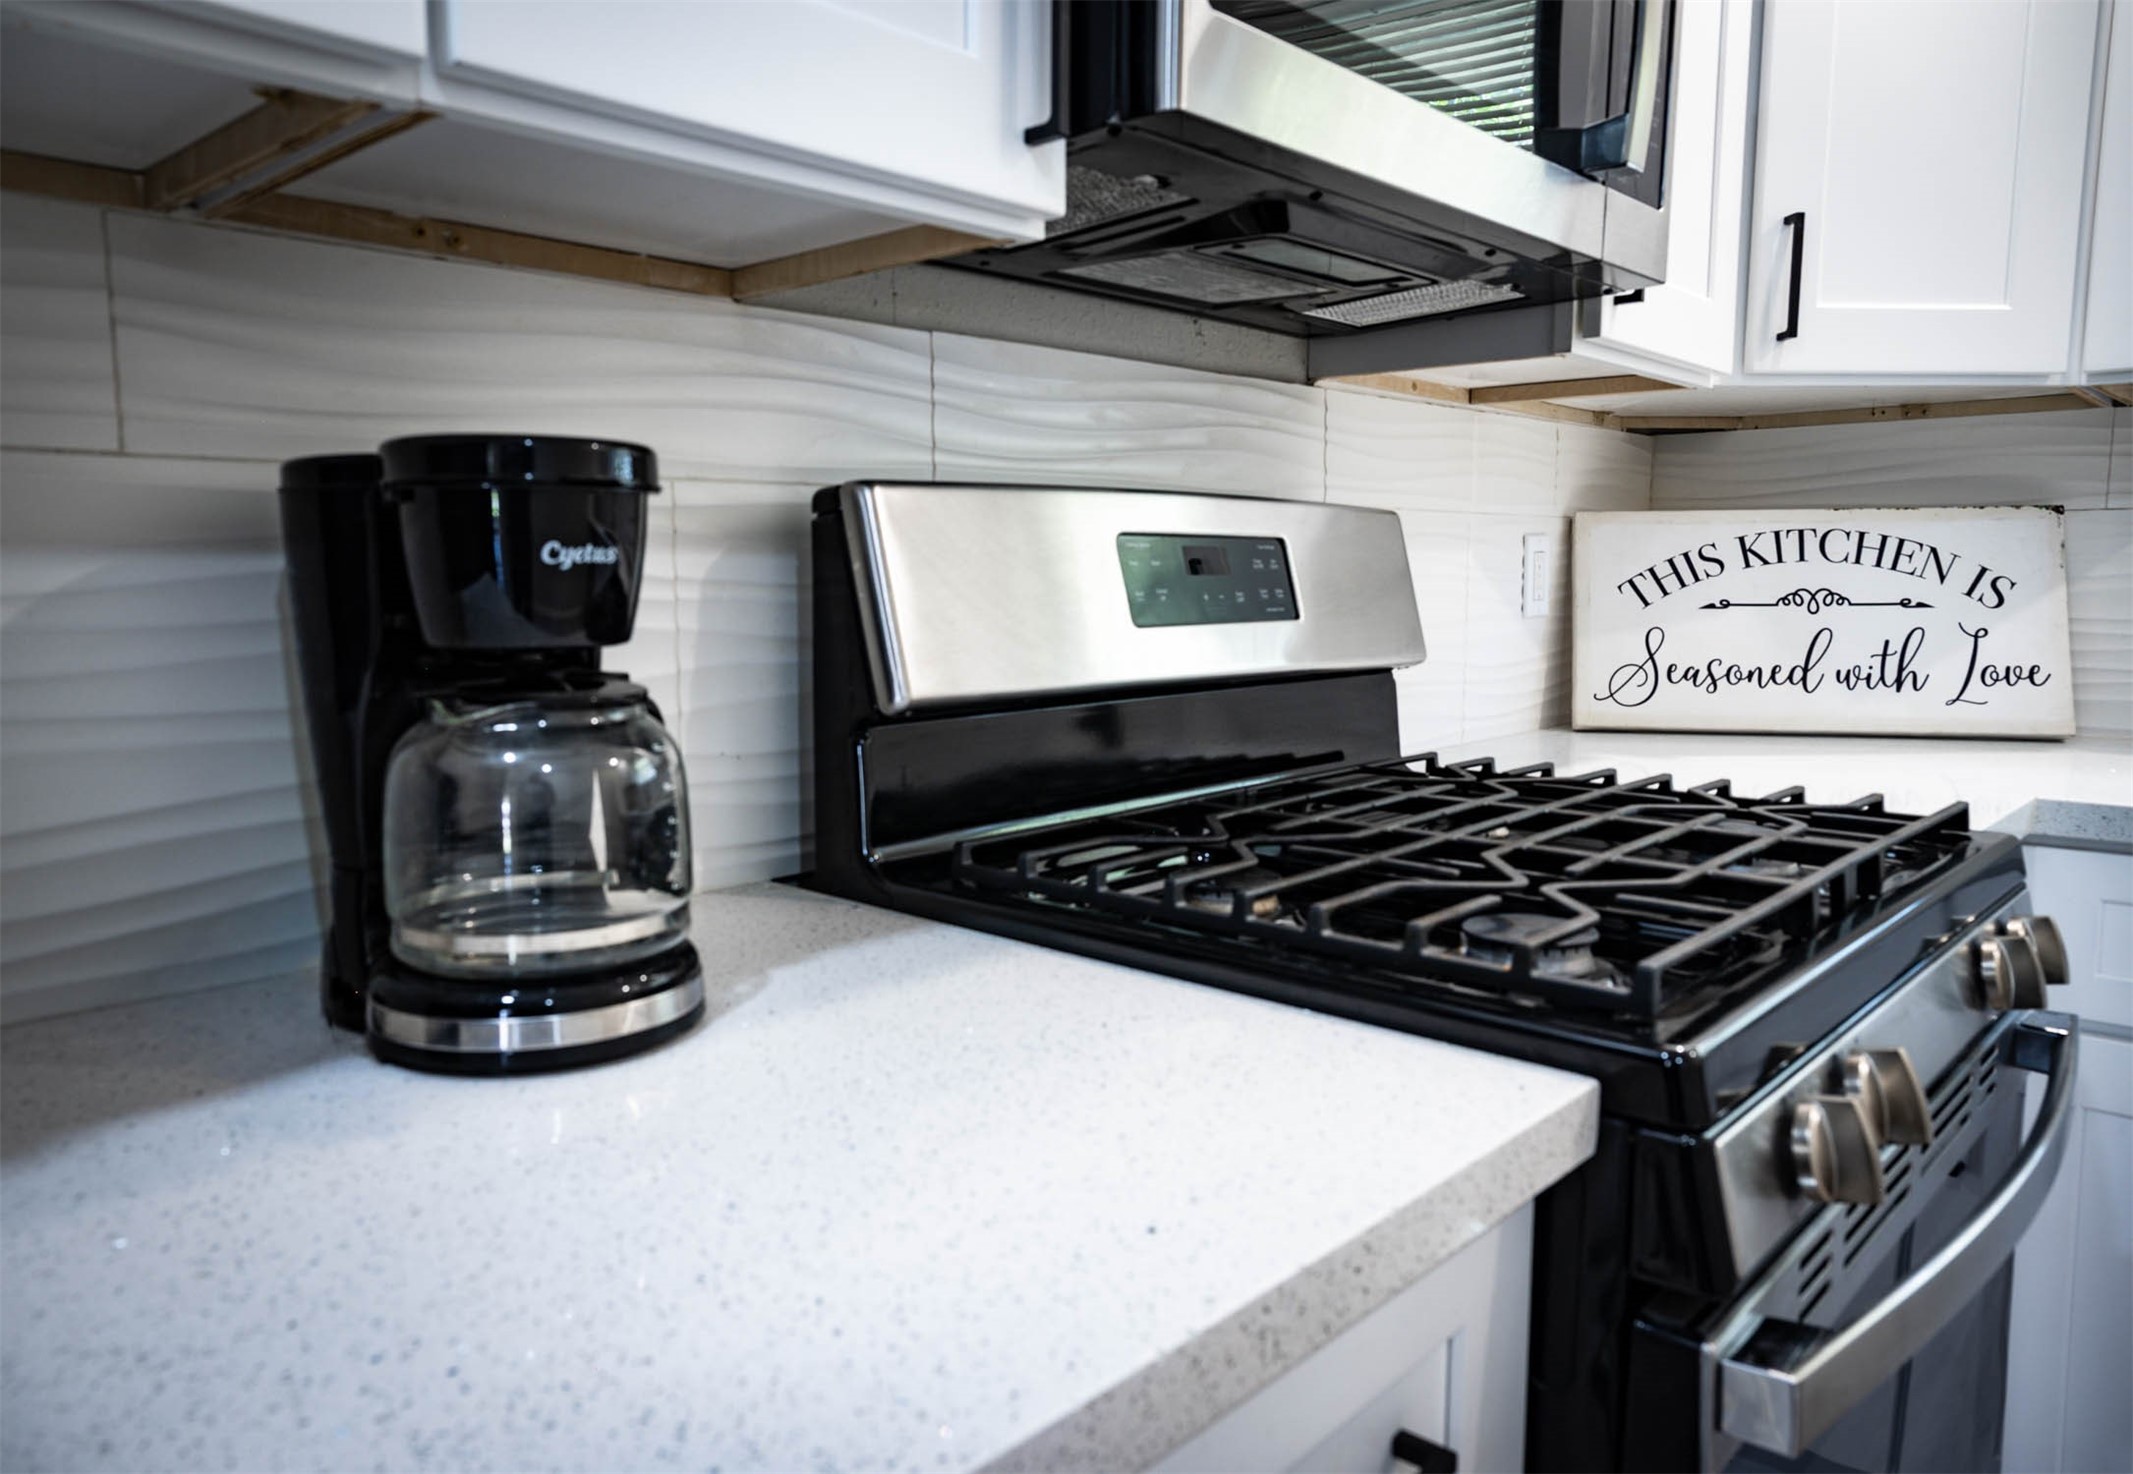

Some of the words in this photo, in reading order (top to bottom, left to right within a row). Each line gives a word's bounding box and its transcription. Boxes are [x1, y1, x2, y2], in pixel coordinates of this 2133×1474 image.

[1616, 542, 1726, 609] THIS
[1734, 527, 1961, 585] KITCHEN
[1961, 563, 2018, 610] IS
[1593, 626, 1833, 708] Seasoned
[1835, 626, 1930, 694] with
[1944, 621, 2052, 706] Love
